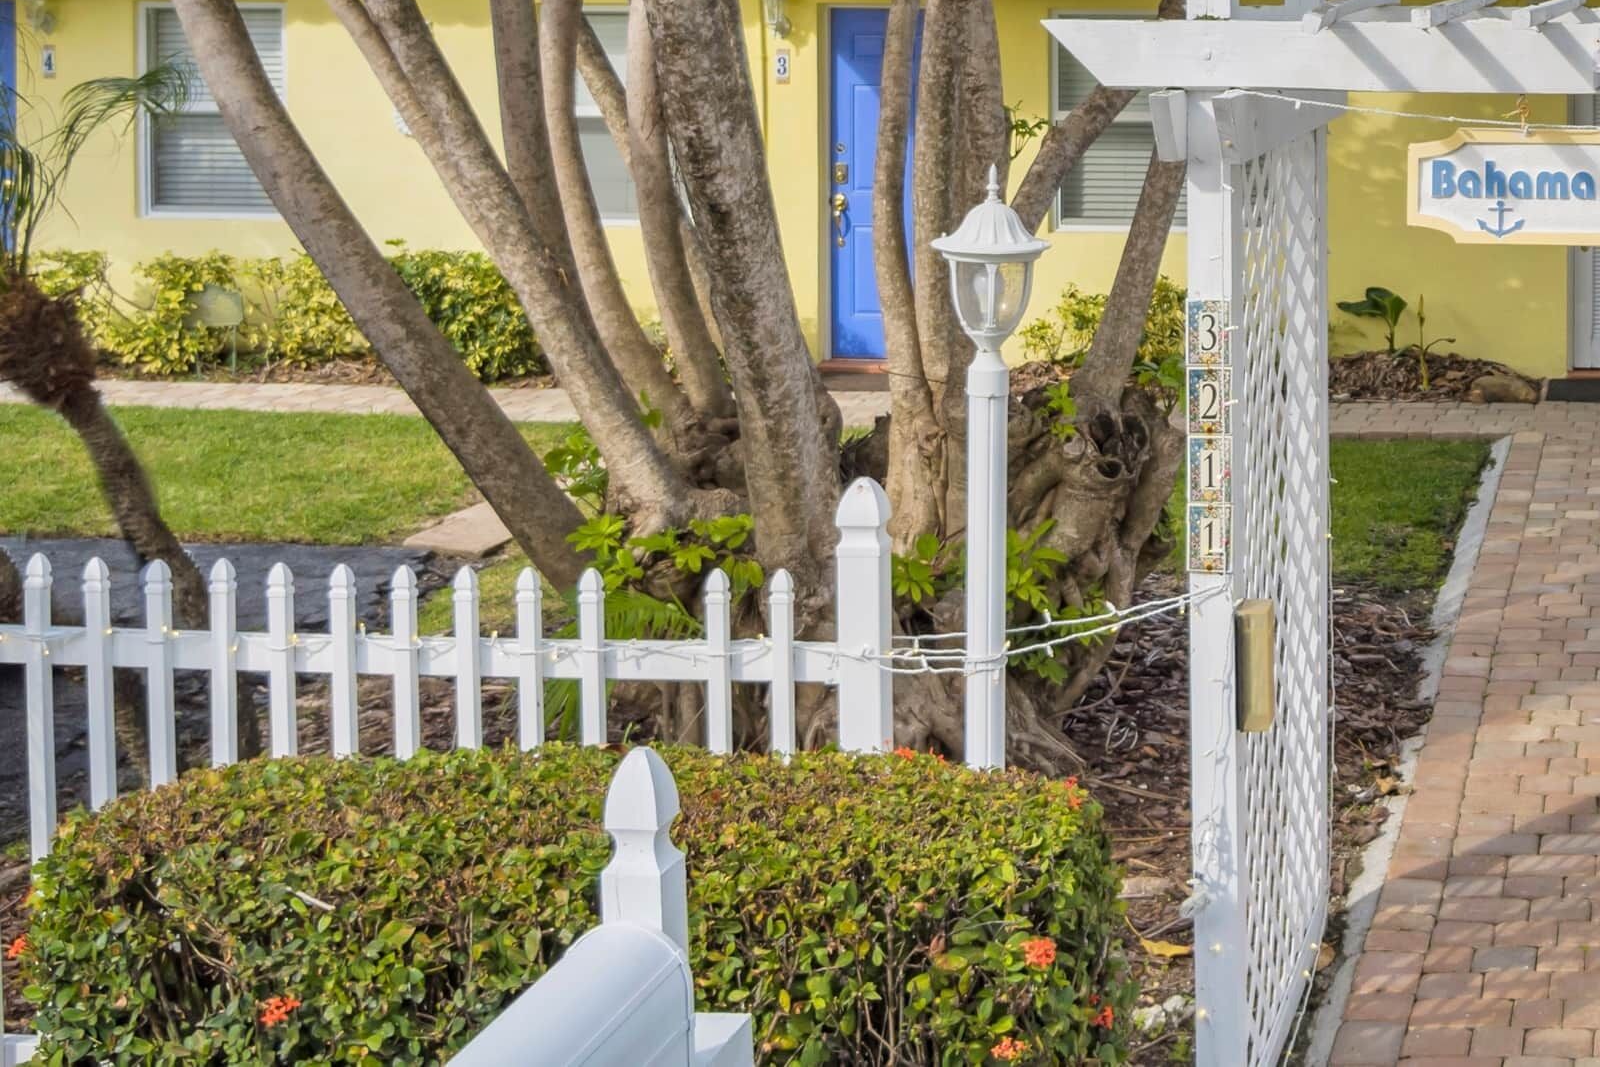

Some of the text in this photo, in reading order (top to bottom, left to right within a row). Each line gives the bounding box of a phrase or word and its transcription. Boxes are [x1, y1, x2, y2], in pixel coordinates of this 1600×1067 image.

[44, 53, 53, 71] 4
[777, 56, 787, 75] 3
[1432, 160, 1597, 200] Bahama
